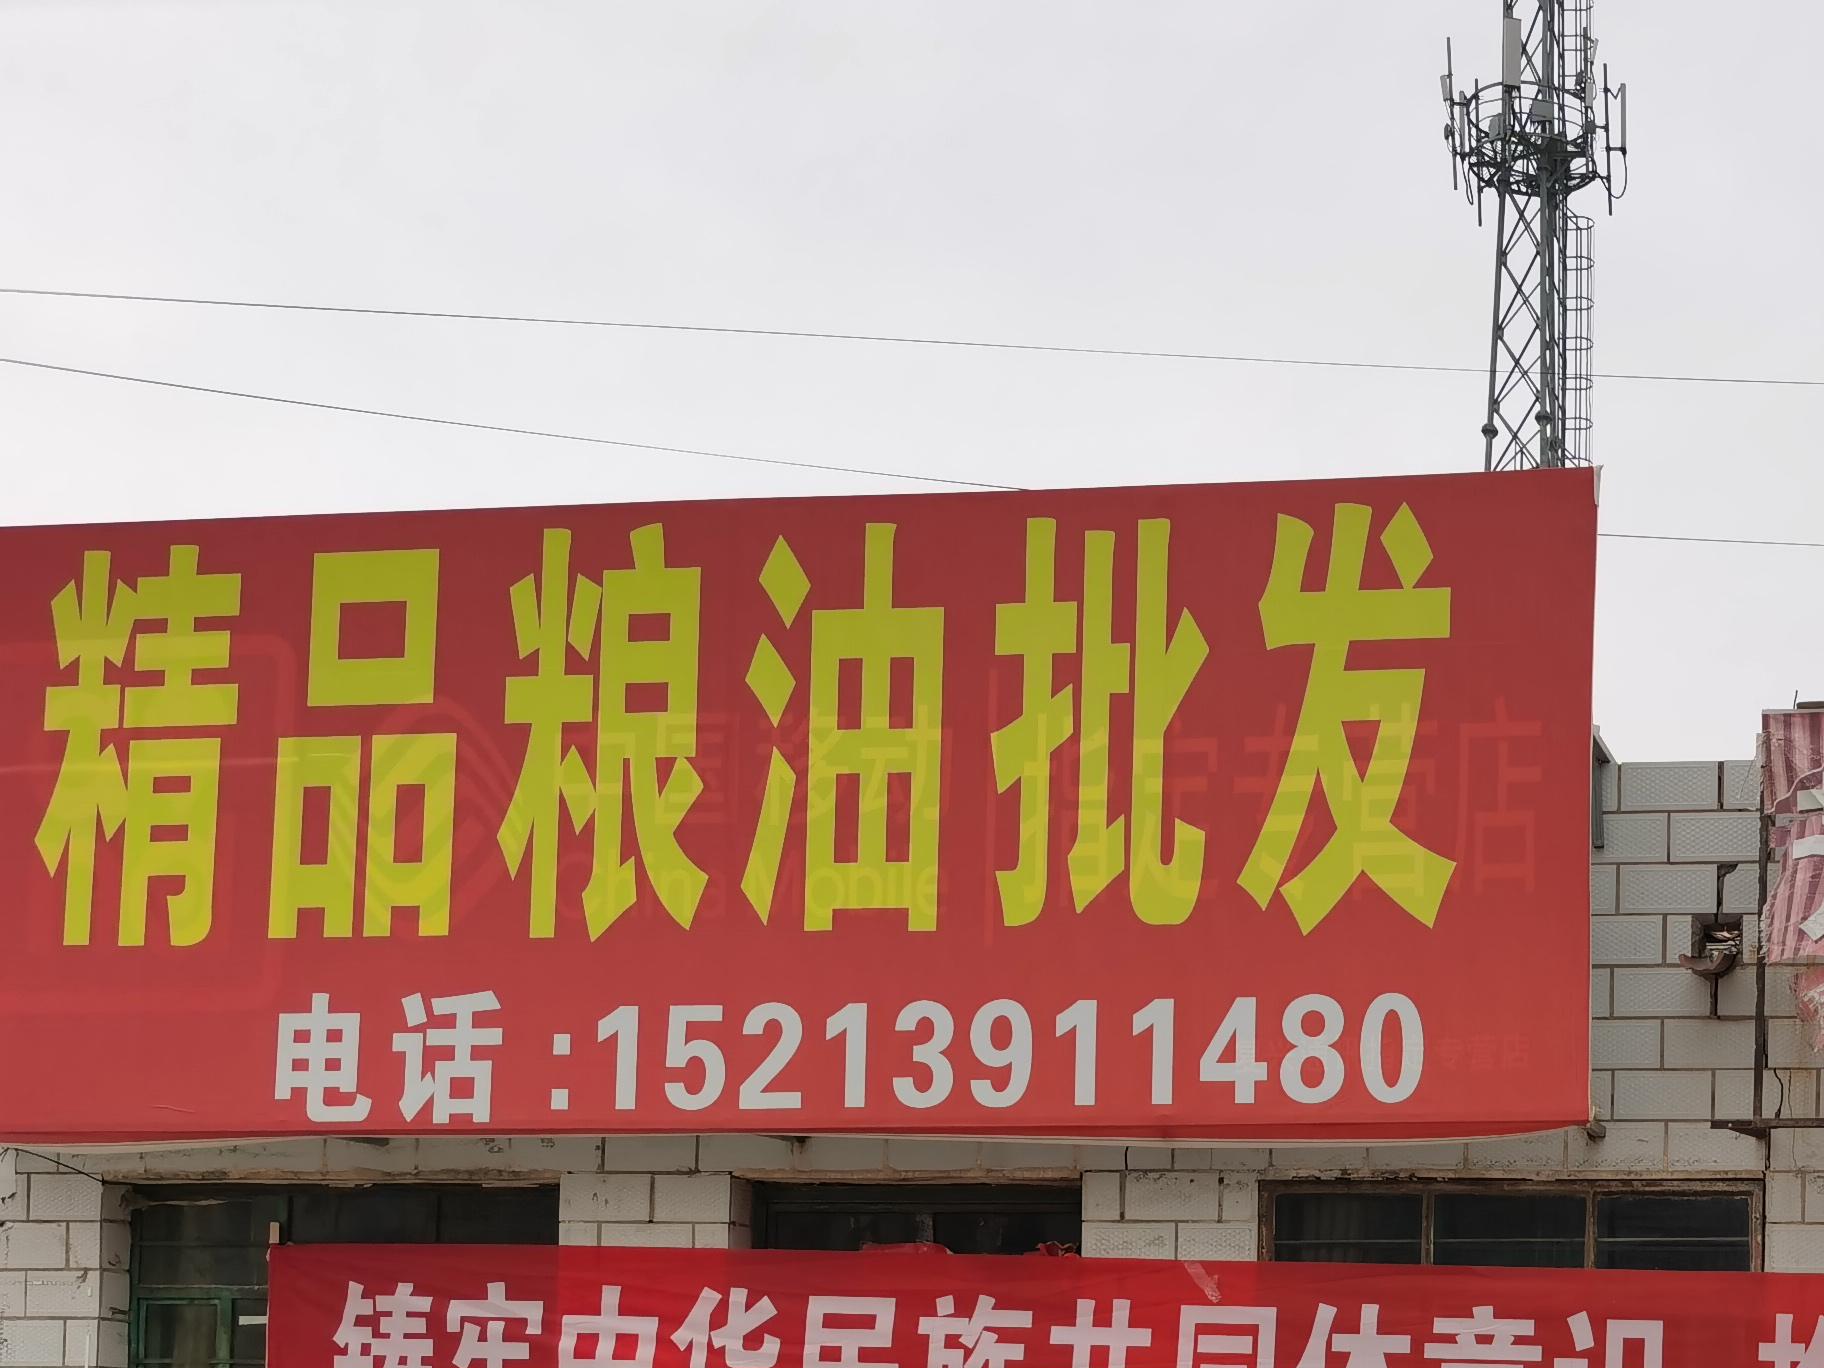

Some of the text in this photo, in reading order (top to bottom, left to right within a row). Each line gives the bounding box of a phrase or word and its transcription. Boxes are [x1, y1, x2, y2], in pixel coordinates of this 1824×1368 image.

[35, 501, 1457, 947] 精品粮油批发
